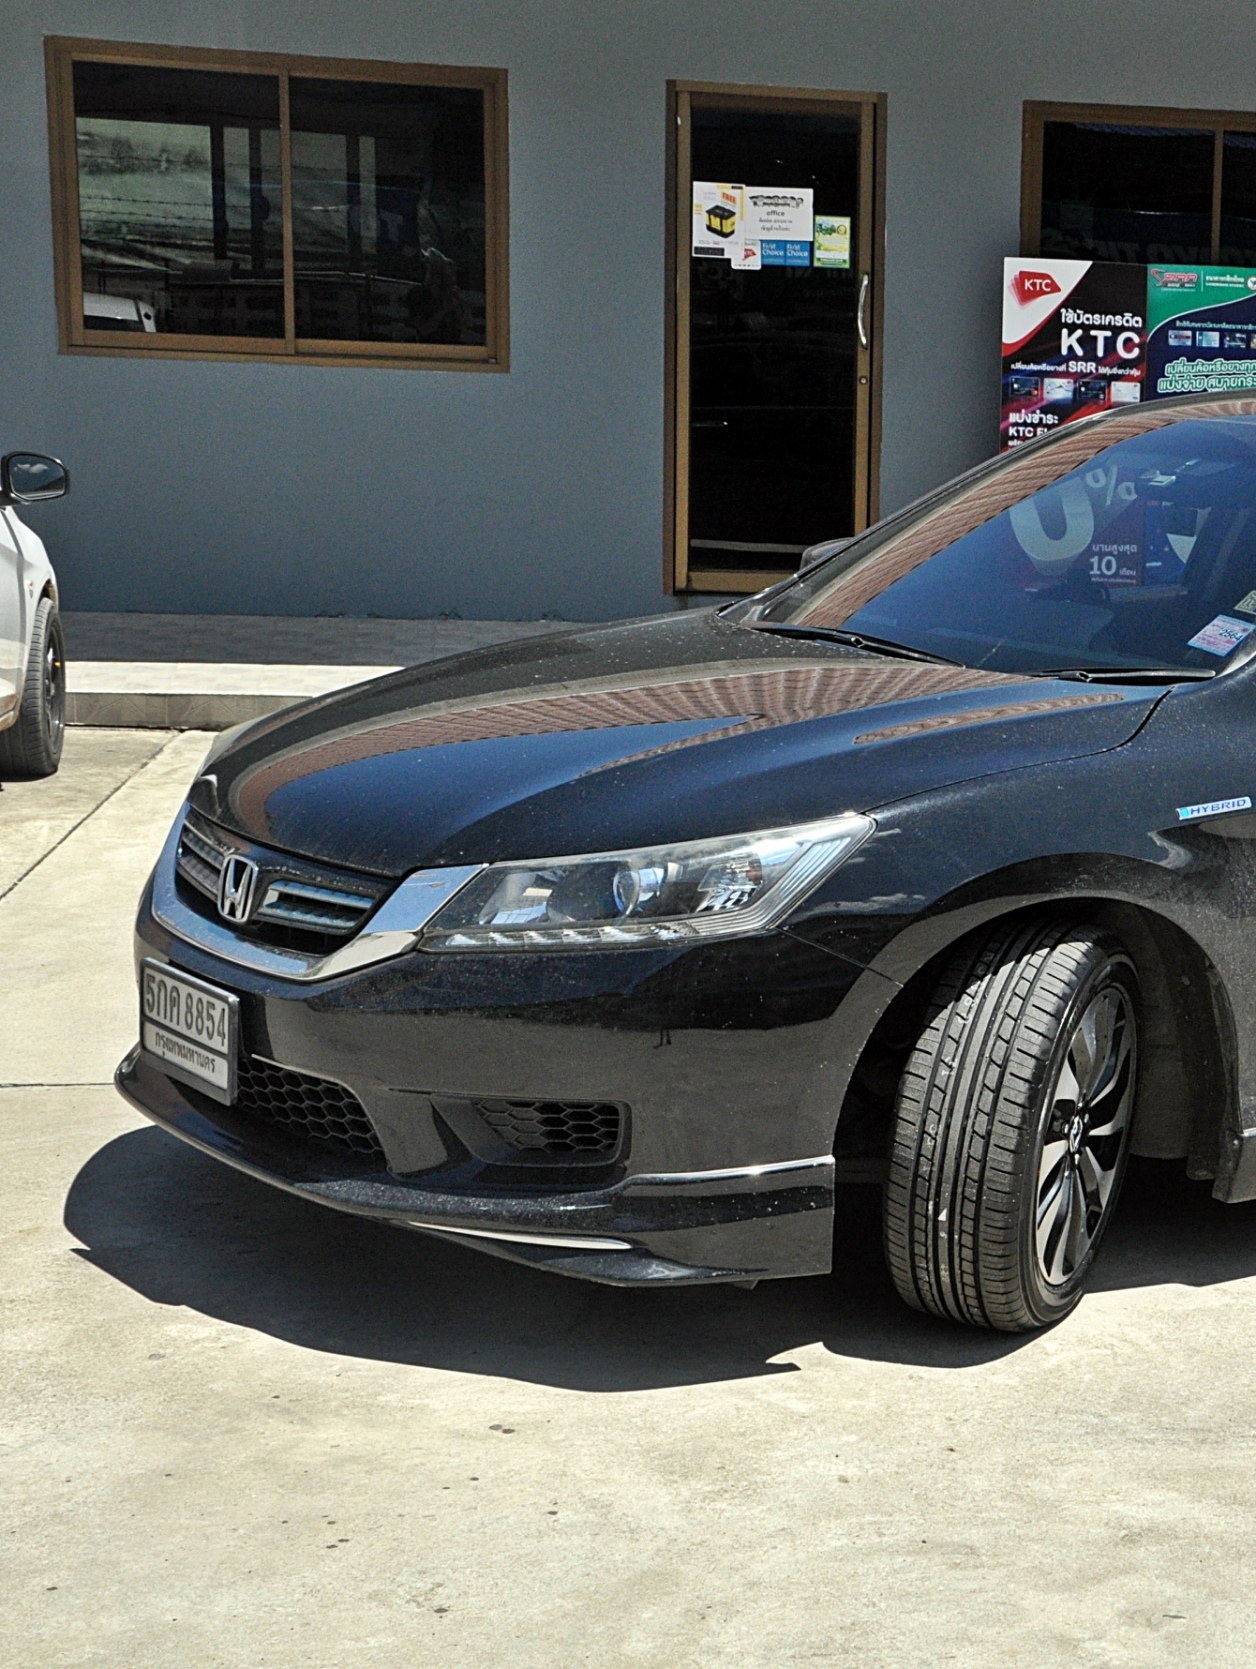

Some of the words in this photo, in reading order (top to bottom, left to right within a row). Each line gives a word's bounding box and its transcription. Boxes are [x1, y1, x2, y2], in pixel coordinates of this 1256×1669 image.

[1024, 279, 1051, 291] KTC
[1060, 308, 1142, 327] ใช้บัตรเครดิต
[1061, 328, 1140, 359] KTC
[1068, 360, 1097, 373] SRR
[1158, 375, 1206, 392] แบ่งจ่าย
[1009, 409, 1059, 424] แบ่งชำระ
[1009, 426, 1034, 437] KTC
[1092, 544, 1137, 555] นานสูงสุด
[1089, 555, 1117, 575] 10
[1119, 567, 1136, 576] เดือน
[1190, 799, 1246, 815] HYBRID
[184, 992, 226, 1047] 8854
[155, 1031, 215, 1074] กรุงเทพมหานคร
